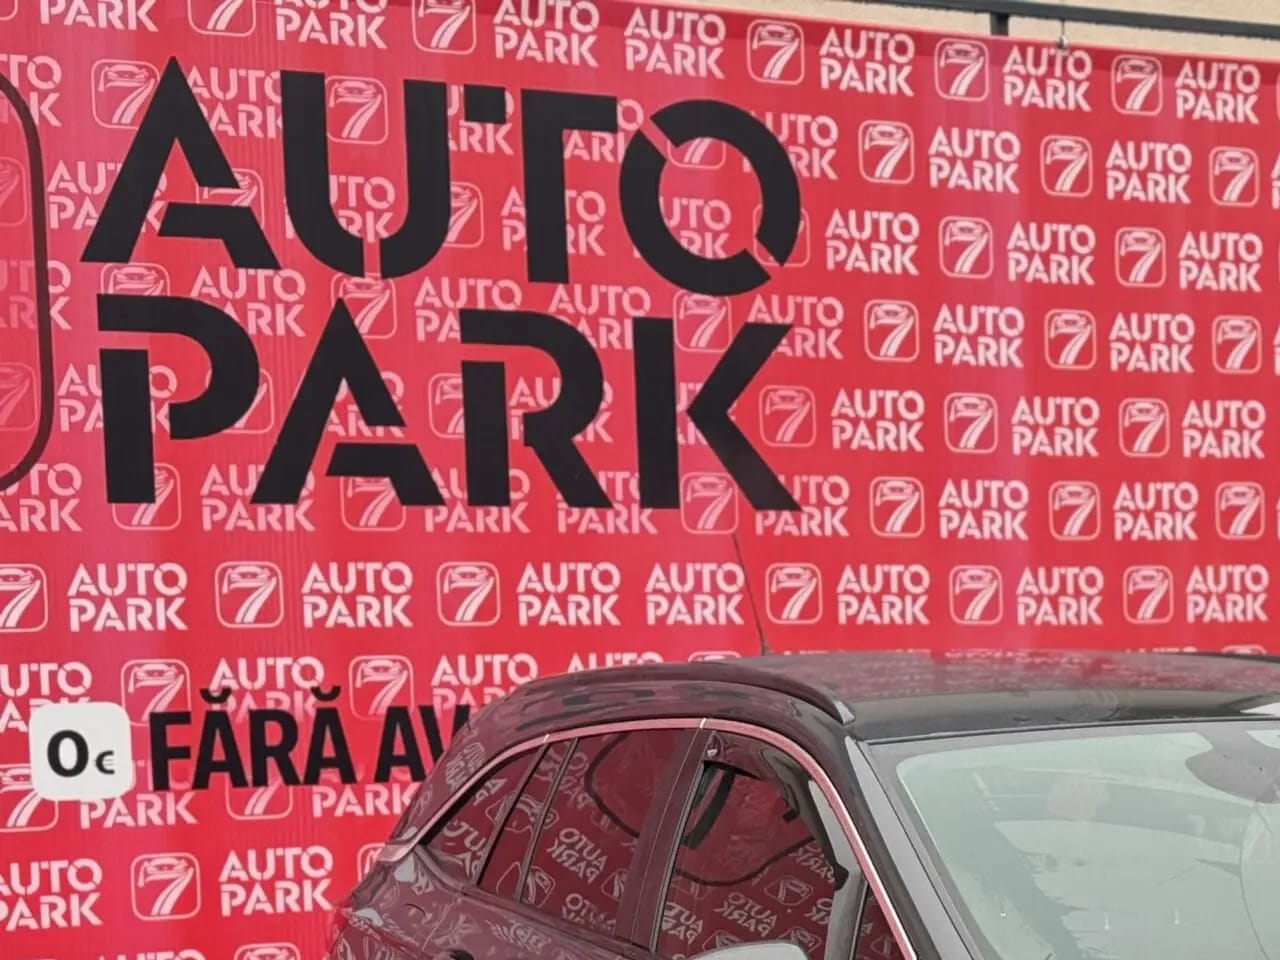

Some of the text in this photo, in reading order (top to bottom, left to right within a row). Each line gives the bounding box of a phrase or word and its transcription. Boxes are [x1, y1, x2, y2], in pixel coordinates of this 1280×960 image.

[40, 0, 159, 32] PARK
[276, 8, 387, 49] PARK
[493, 0, 600, 33] AUTO
[623, 6, 727, 46] AUTO
[494, 25, 598, 67] PARK
[625, 38, 724, 79] PARK
[819, 25, 915, 63] AUTO
[820, 57, 914, 97] PARK
[1003, 43, 1093, 80] AUTO
[1174, 59, 1261, 93] AUTO
[1003, 74, 1091, 112] PARK
[1175, 88, 1259, 124] PARK
[928, 126, 1021, 162] AUTO
[1105, 140, 1192, 174] AUTO
[79, 55, 802, 297] AUTO
[929, 156, 1019, 194] PARK
[1106, 169, 1191, 204] PARK
[825, 208, 920, 244] AUTO
[1006, 220, 1096, 255] AUTO
[826, 239, 919, 275] PARK
[1178, 230, 1263, 263] AUTO
[190, 265, 306, 302] AUTO
[1007, 250, 1095, 285] PARK
[1179, 259, 1261, 292] PARK
[414, 276, 523, 311] AUTO
[548, 283, 651, 317] AUTO
[747, 293, 845, 328] AUTO
[933, 303, 1025, 337] AUTO
[1109, 312, 1195, 344] AUTO
[934, 333, 1023, 368] PARK
[1110, 341, 1194, 373] PARK
[96, 293, 805, 513] PARK
[831, 388, 925, 421] AUTO
[1011, 395, 1100, 427] AUTO
[1181, 399, 1266, 430] AUTO
[832, 419, 924, 452] PARK
[1012, 424, 1098, 457] PARK
[1183, 428, 1265, 459] PARK
[938, 478, 1029, 511] AUTO
[1113, 480, 1199, 511] AUTO
[0, 498, 82, 532] ARK
[201, 498, 316, 532] PARK
[424, 501, 531, 534] PARK
[557, 502, 658, 535] PARK
[754, 506, 850, 537] PARK
[939, 508, 1028, 541] PARK
[1114, 511, 1197, 541] PARK
[67, 561, 188, 597] AUTO
[301, 560, 413, 594] AUTO
[517, 561, 621, 594] AUTO
[645, 561, 745, 594] AUTO
[837, 563, 930, 595] AUTO
[1016, 565, 1104, 596] AUTO
[1186, 563, 1269, 595] AUTO
[69, 597, 187, 632] PARK
[303, 594, 413, 628] PARK
[518, 594, 621, 626] PARK
[646, 594, 744, 625] PARK
[838, 594, 929, 625] PARK
[1017, 595, 1103, 625] PARK
[1187, 592, 1267, 623] PARK
[209, 655, 326, 691] AUTO
[431, 652, 539, 687] AUTO
[150, 686, 357, 791] FĂRĂ
[80, 791, 199, 830] PARK
[219, 844, 334, 883] AUTO
[221, 878, 333, 917] PARK
